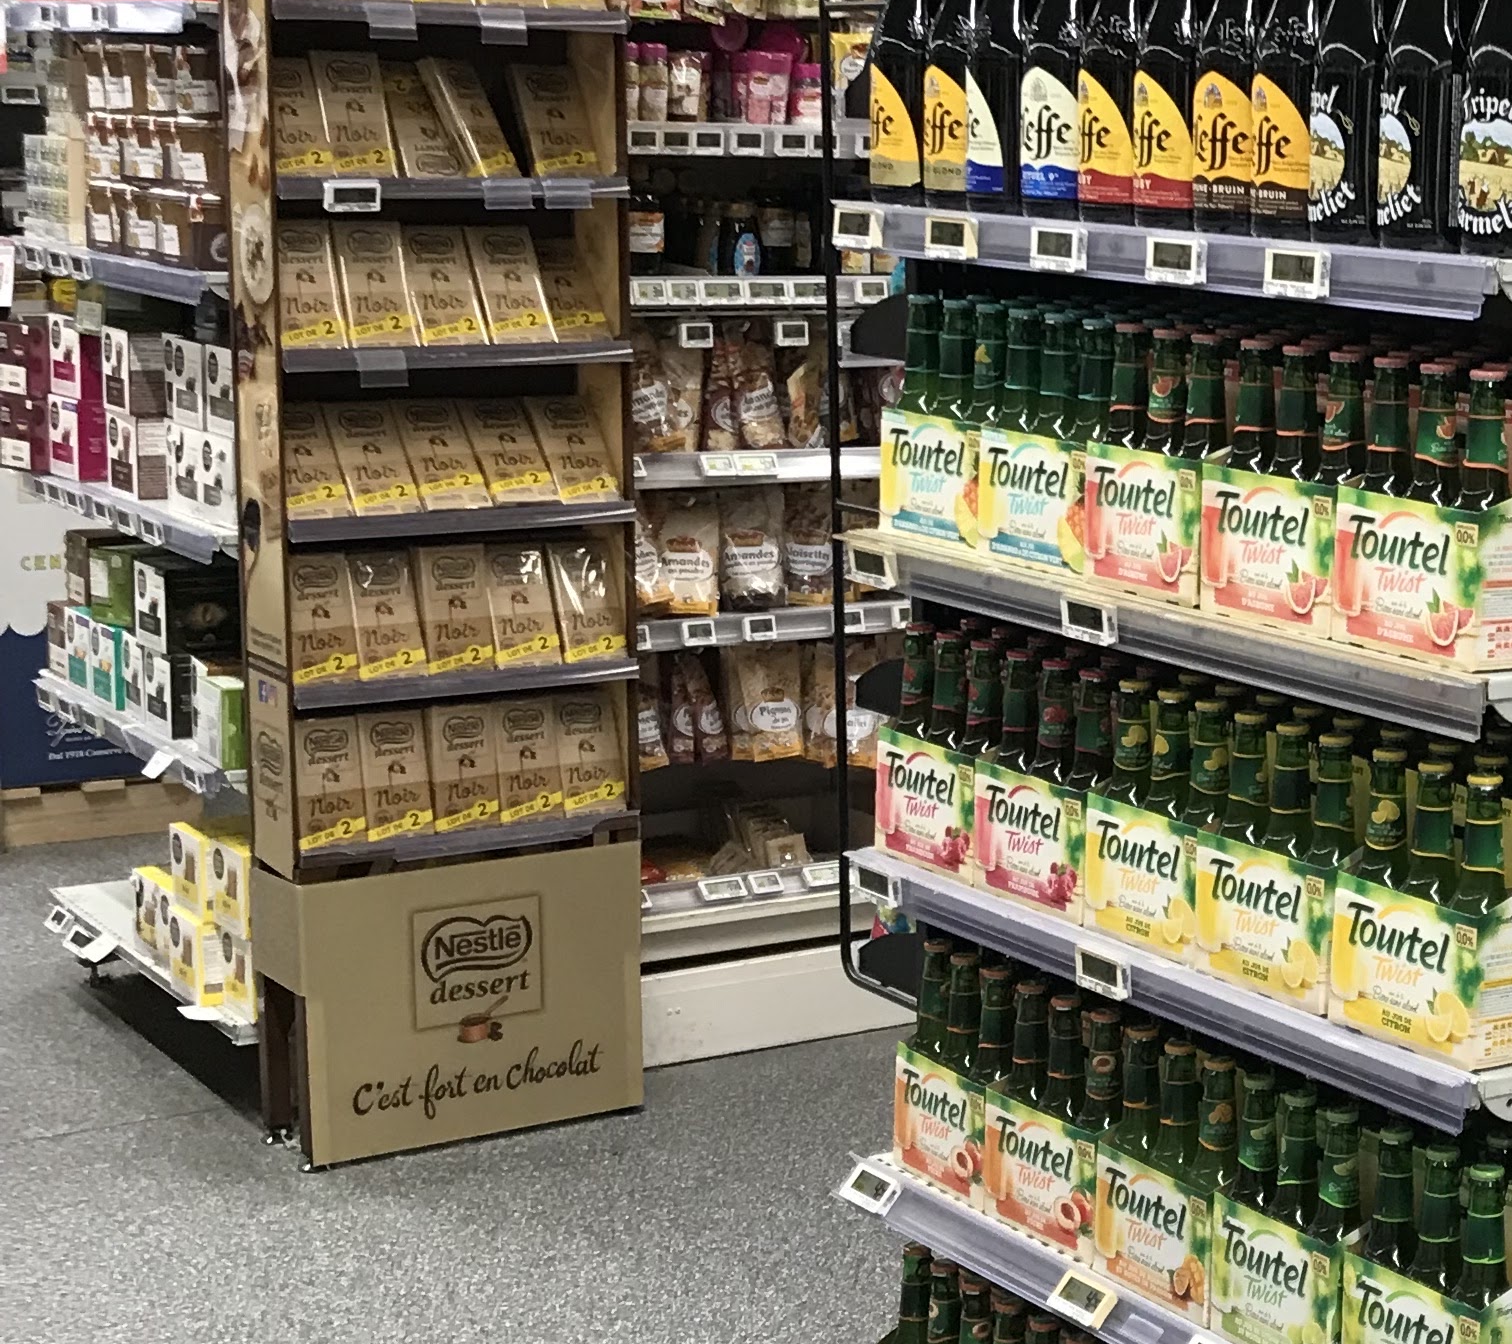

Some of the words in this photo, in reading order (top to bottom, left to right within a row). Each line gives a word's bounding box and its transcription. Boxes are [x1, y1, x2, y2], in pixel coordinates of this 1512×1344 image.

[889, 427, 966, 477] Tourtel
[988, 447, 1069, 499] Tourtel
[1094, 465, 1177, 519] Tourtel
[1215, 490, 1309, 548] Tourtel
[1349, 514, 1451, 576] Tourtel
[886, 750, 957, 807] Tourtel
[986, 783, 1062, 843] Tourtel
[1096, 819, 1183, 882] Tourtel
[1209, 857, 1302, 924] Tourtel
[1347, 901, 1451, 976] Tourtel
[430, 969, 532, 1006] dessert
[352, 1080, 413, 1117] C'est
[417, 1064, 466, 1121] fort
[473, 1071, 503, 1095] en
[902, 1067, 968, 1132] Tourtel
[995, 1114, 1074, 1182] Tourtel
[1105, 1166, 1187, 1242] Tourtel
[1222, 1218, 1309, 1300] Tourtel
